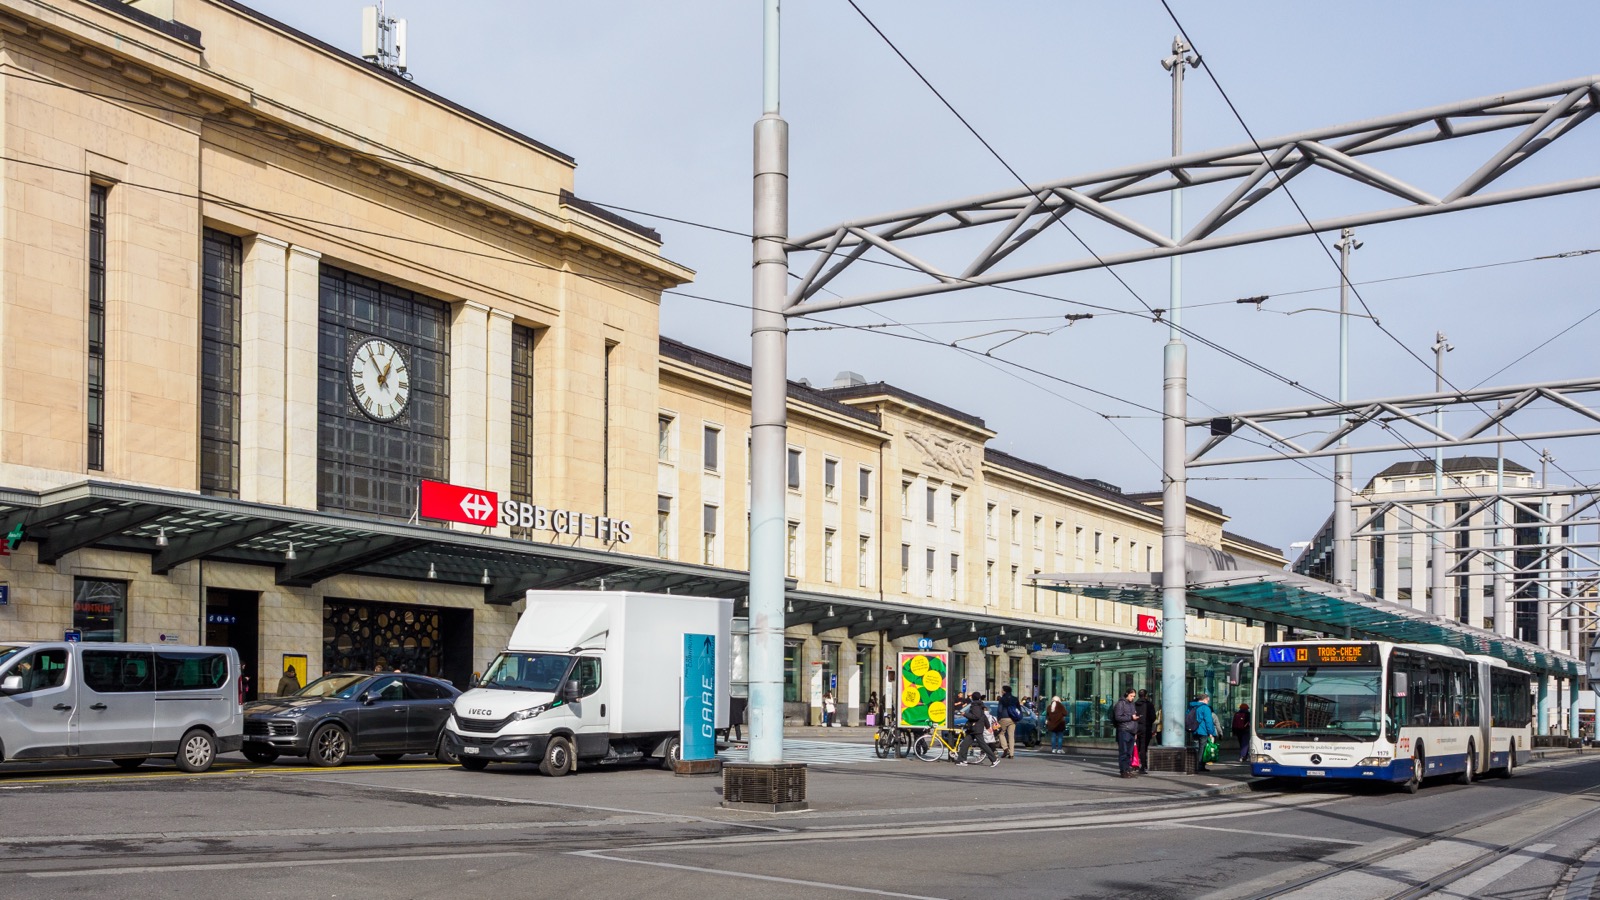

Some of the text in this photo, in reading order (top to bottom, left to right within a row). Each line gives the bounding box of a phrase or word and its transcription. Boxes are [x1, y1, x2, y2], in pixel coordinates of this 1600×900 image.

[503, 499, 633, 544] SBB CFF FFS
[1277, 649, 1285, 661] 1
[1317, 646, 1362, 657] TROIS-CHENE
[468, 708, 492, 716] IVECO
[701, 674, 713, 739] GARE
